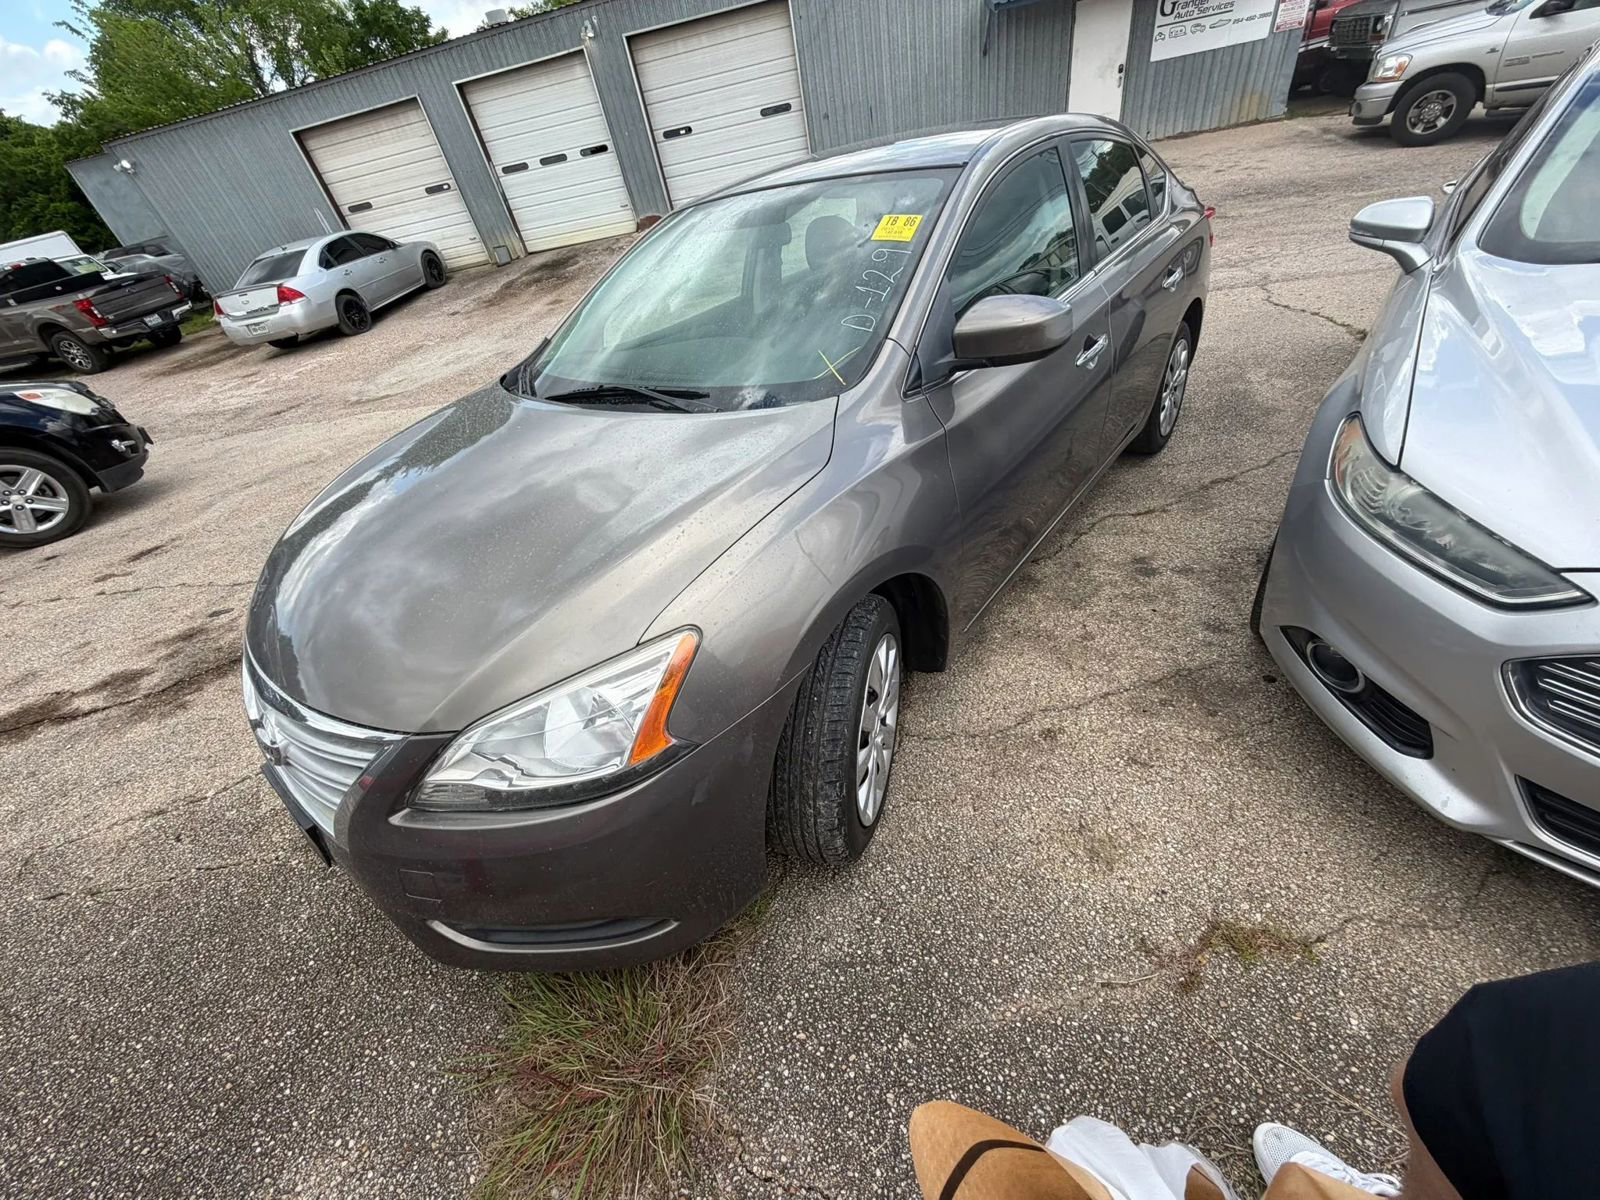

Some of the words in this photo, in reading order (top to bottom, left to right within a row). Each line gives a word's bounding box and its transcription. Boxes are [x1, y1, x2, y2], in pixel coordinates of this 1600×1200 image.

[1174, 9, 1195, 20] Auto
[1196, 1, 1235, 15] Services
[903, 216, 918, 227] 86
[841, 248, 912, 332] D-129
